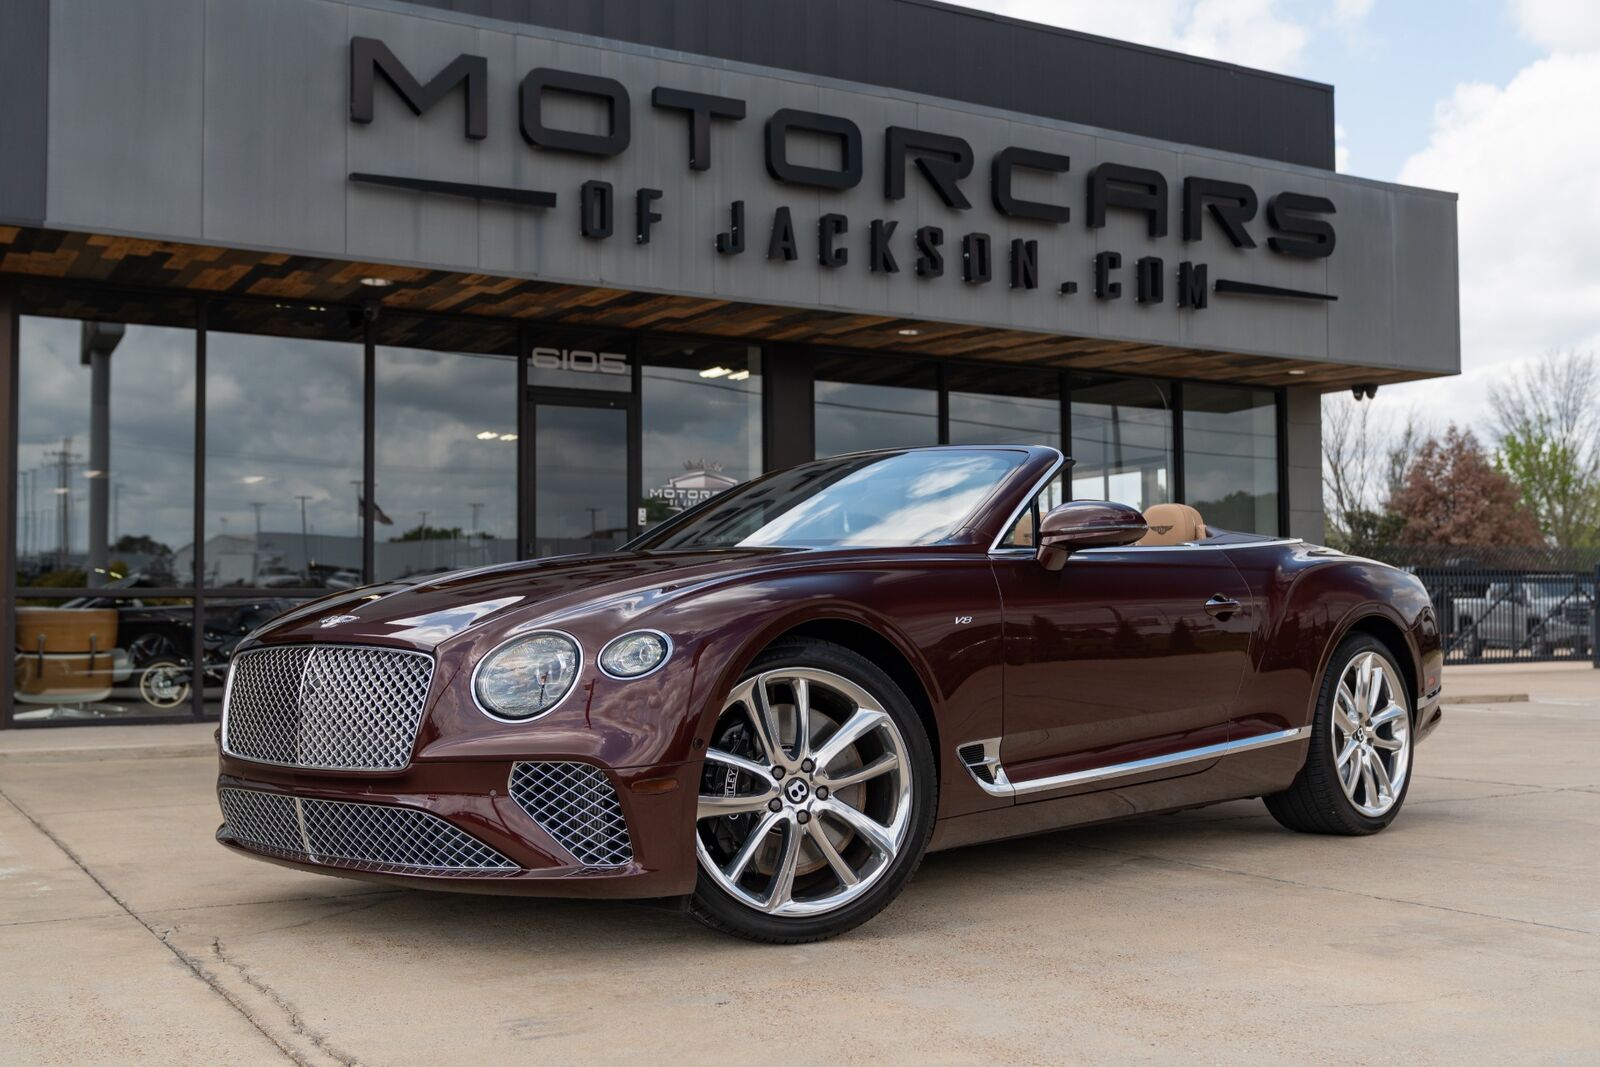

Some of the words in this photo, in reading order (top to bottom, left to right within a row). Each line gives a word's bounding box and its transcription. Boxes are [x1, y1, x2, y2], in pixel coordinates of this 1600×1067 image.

[350, 36, 1337, 259] MOTORCARS
[580, 179, 663, 244] OF
[531, 347, 627, 374] 6105
[955, 616, 972, 625] V8
